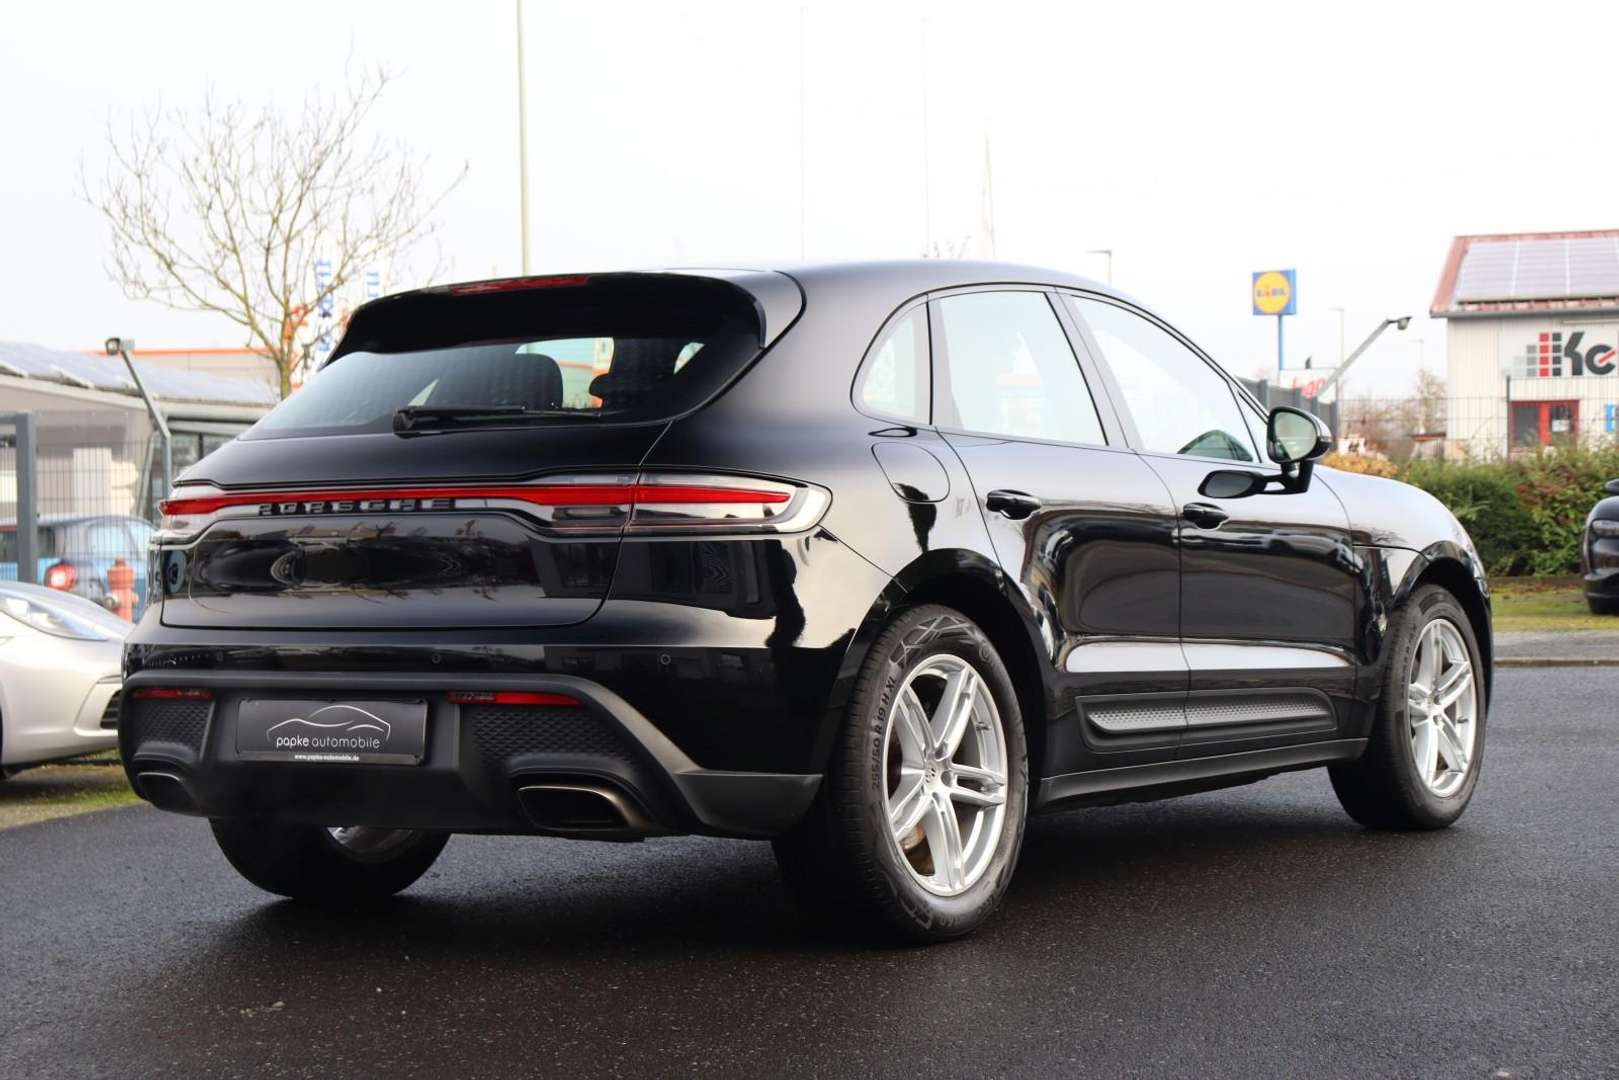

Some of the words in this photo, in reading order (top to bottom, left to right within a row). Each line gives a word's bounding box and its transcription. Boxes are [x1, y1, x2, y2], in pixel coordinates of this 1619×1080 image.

[885, 675, 897, 691] XL
[881, 692, 890, 706] H
[877, 707, 886, 722] 19
[874, 724, 883, 735] R
[276, 735, 309, 748] papke
[311, 735, 380, 749] automobile
[871, 738, 881, 791] 255/50
